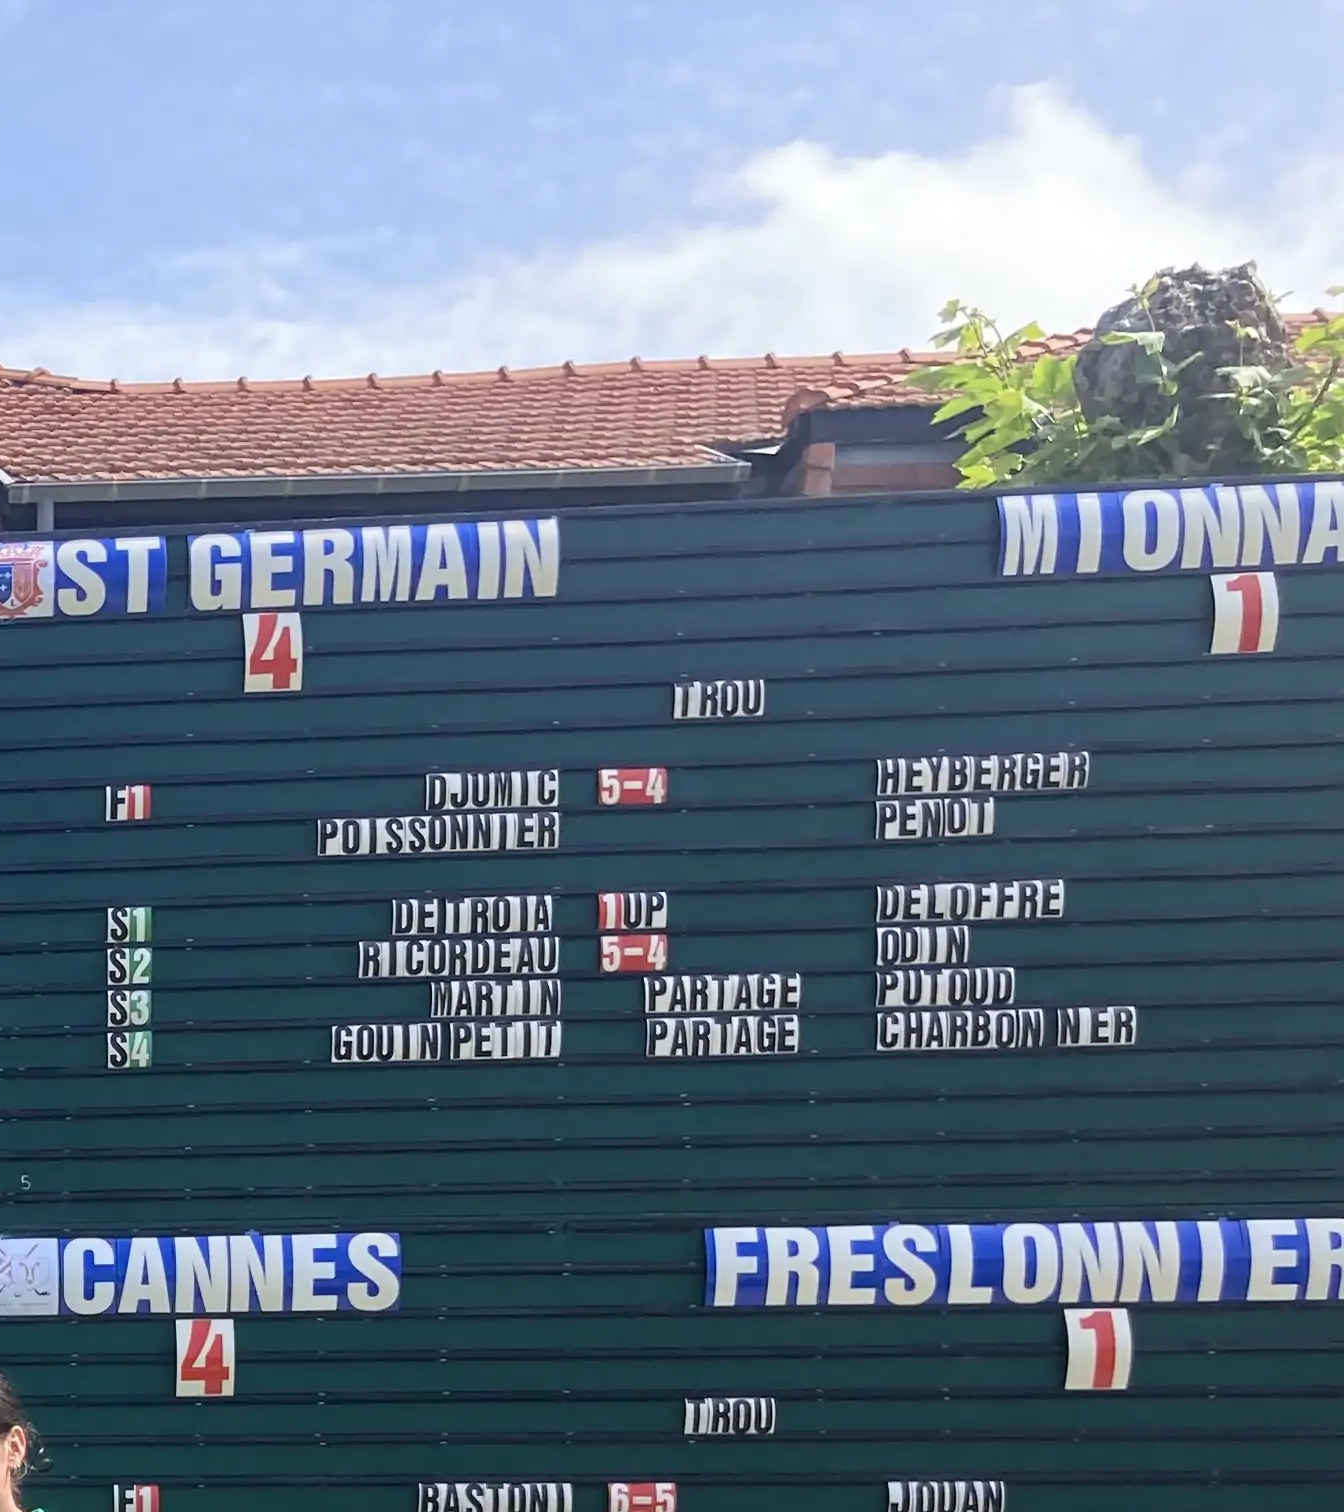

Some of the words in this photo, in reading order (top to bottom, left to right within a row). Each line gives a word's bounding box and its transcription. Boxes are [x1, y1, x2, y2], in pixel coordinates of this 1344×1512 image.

[57, 536, 162, 616] ST
[190, 517, 559, 612] GERMAIN
[247, 612, 299, 689] 4
[1224, 572, 1264, 653] 1
[676, 681, 763, 718] TROU
[108, 785, 147, 820] F1
[426, 769, 559, 810] DJUMIC
[600, 768, 667, 804] 5-4
[878, 752, 1088, 795] HEYBERGER
[317, 812, 559, 855] POISSONNIER
[877, 797, 994, 839] PENOT
[109, 908, 148, 941] S1
[393, 898, 437, 935] DE
[445, 895, 552, 934] TROIA
[878, 880, 1063, 922] DELOFFRE
[109, 948, 151, 984] S2
[359, 936, 559, 978] RICORDEAU
[600, 935, 667, 972] 5-4
[878, 925, 968, 966] ODIN
[109, 990, 151, 1026] S3
[431, 979, 560, 1017] MARTIN
[646, 973, 800, 1012] PARTAGE
[877, 967, 1014, 1007] PUTOUD
[109, 1032, 151, 1068] S4
[332, 1023, 440, 1062] GOUIN
[451, 1021, 560, 1058] PETIT
[647, 1015, 799, 1056] PARTAGE
[63, 1232, 402, 1315] CANNES
[180, 1319, 231, 1395] 4
[1077, 1310, 1117, 1388] 1
[686, 1397, 775, 1434] TROU
